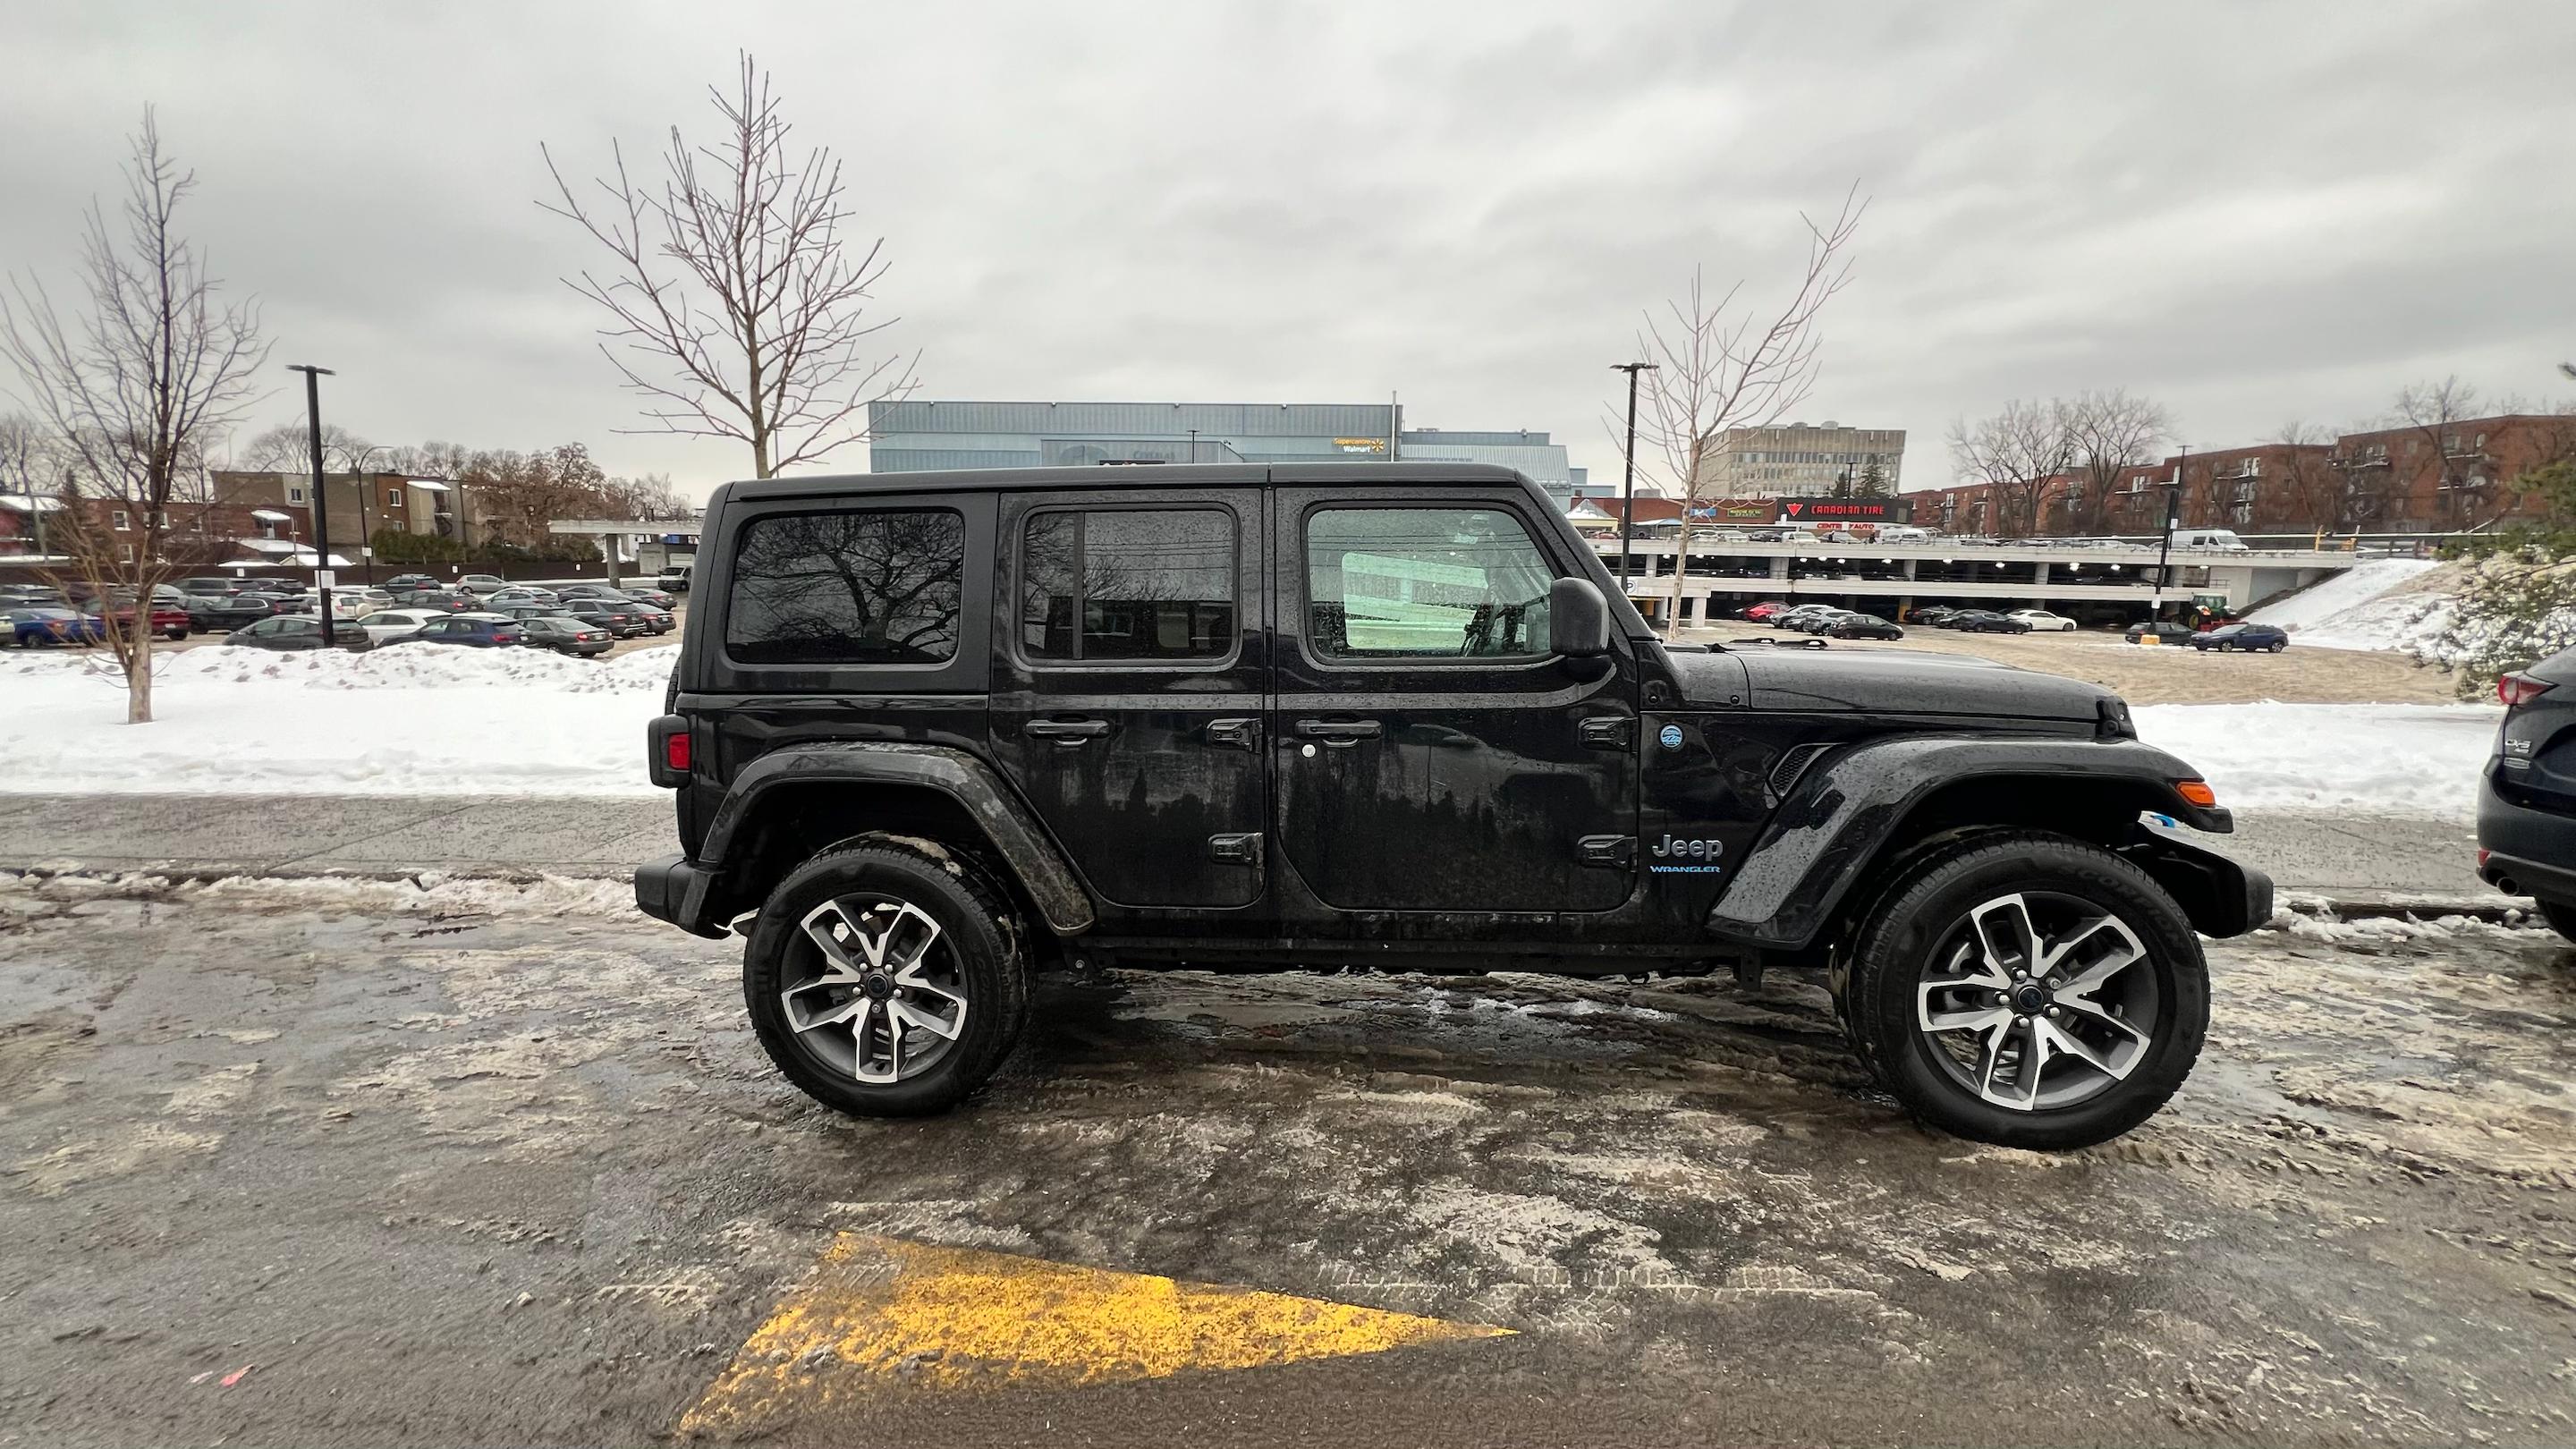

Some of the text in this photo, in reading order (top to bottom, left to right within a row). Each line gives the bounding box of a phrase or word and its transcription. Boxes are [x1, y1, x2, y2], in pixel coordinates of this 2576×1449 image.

[1810, 505, 1885, 515] CANADIAN TIRE
[1652, 834, 1724, 861] Jeep
[1649, 865, 1721, 873] WRANGLER
